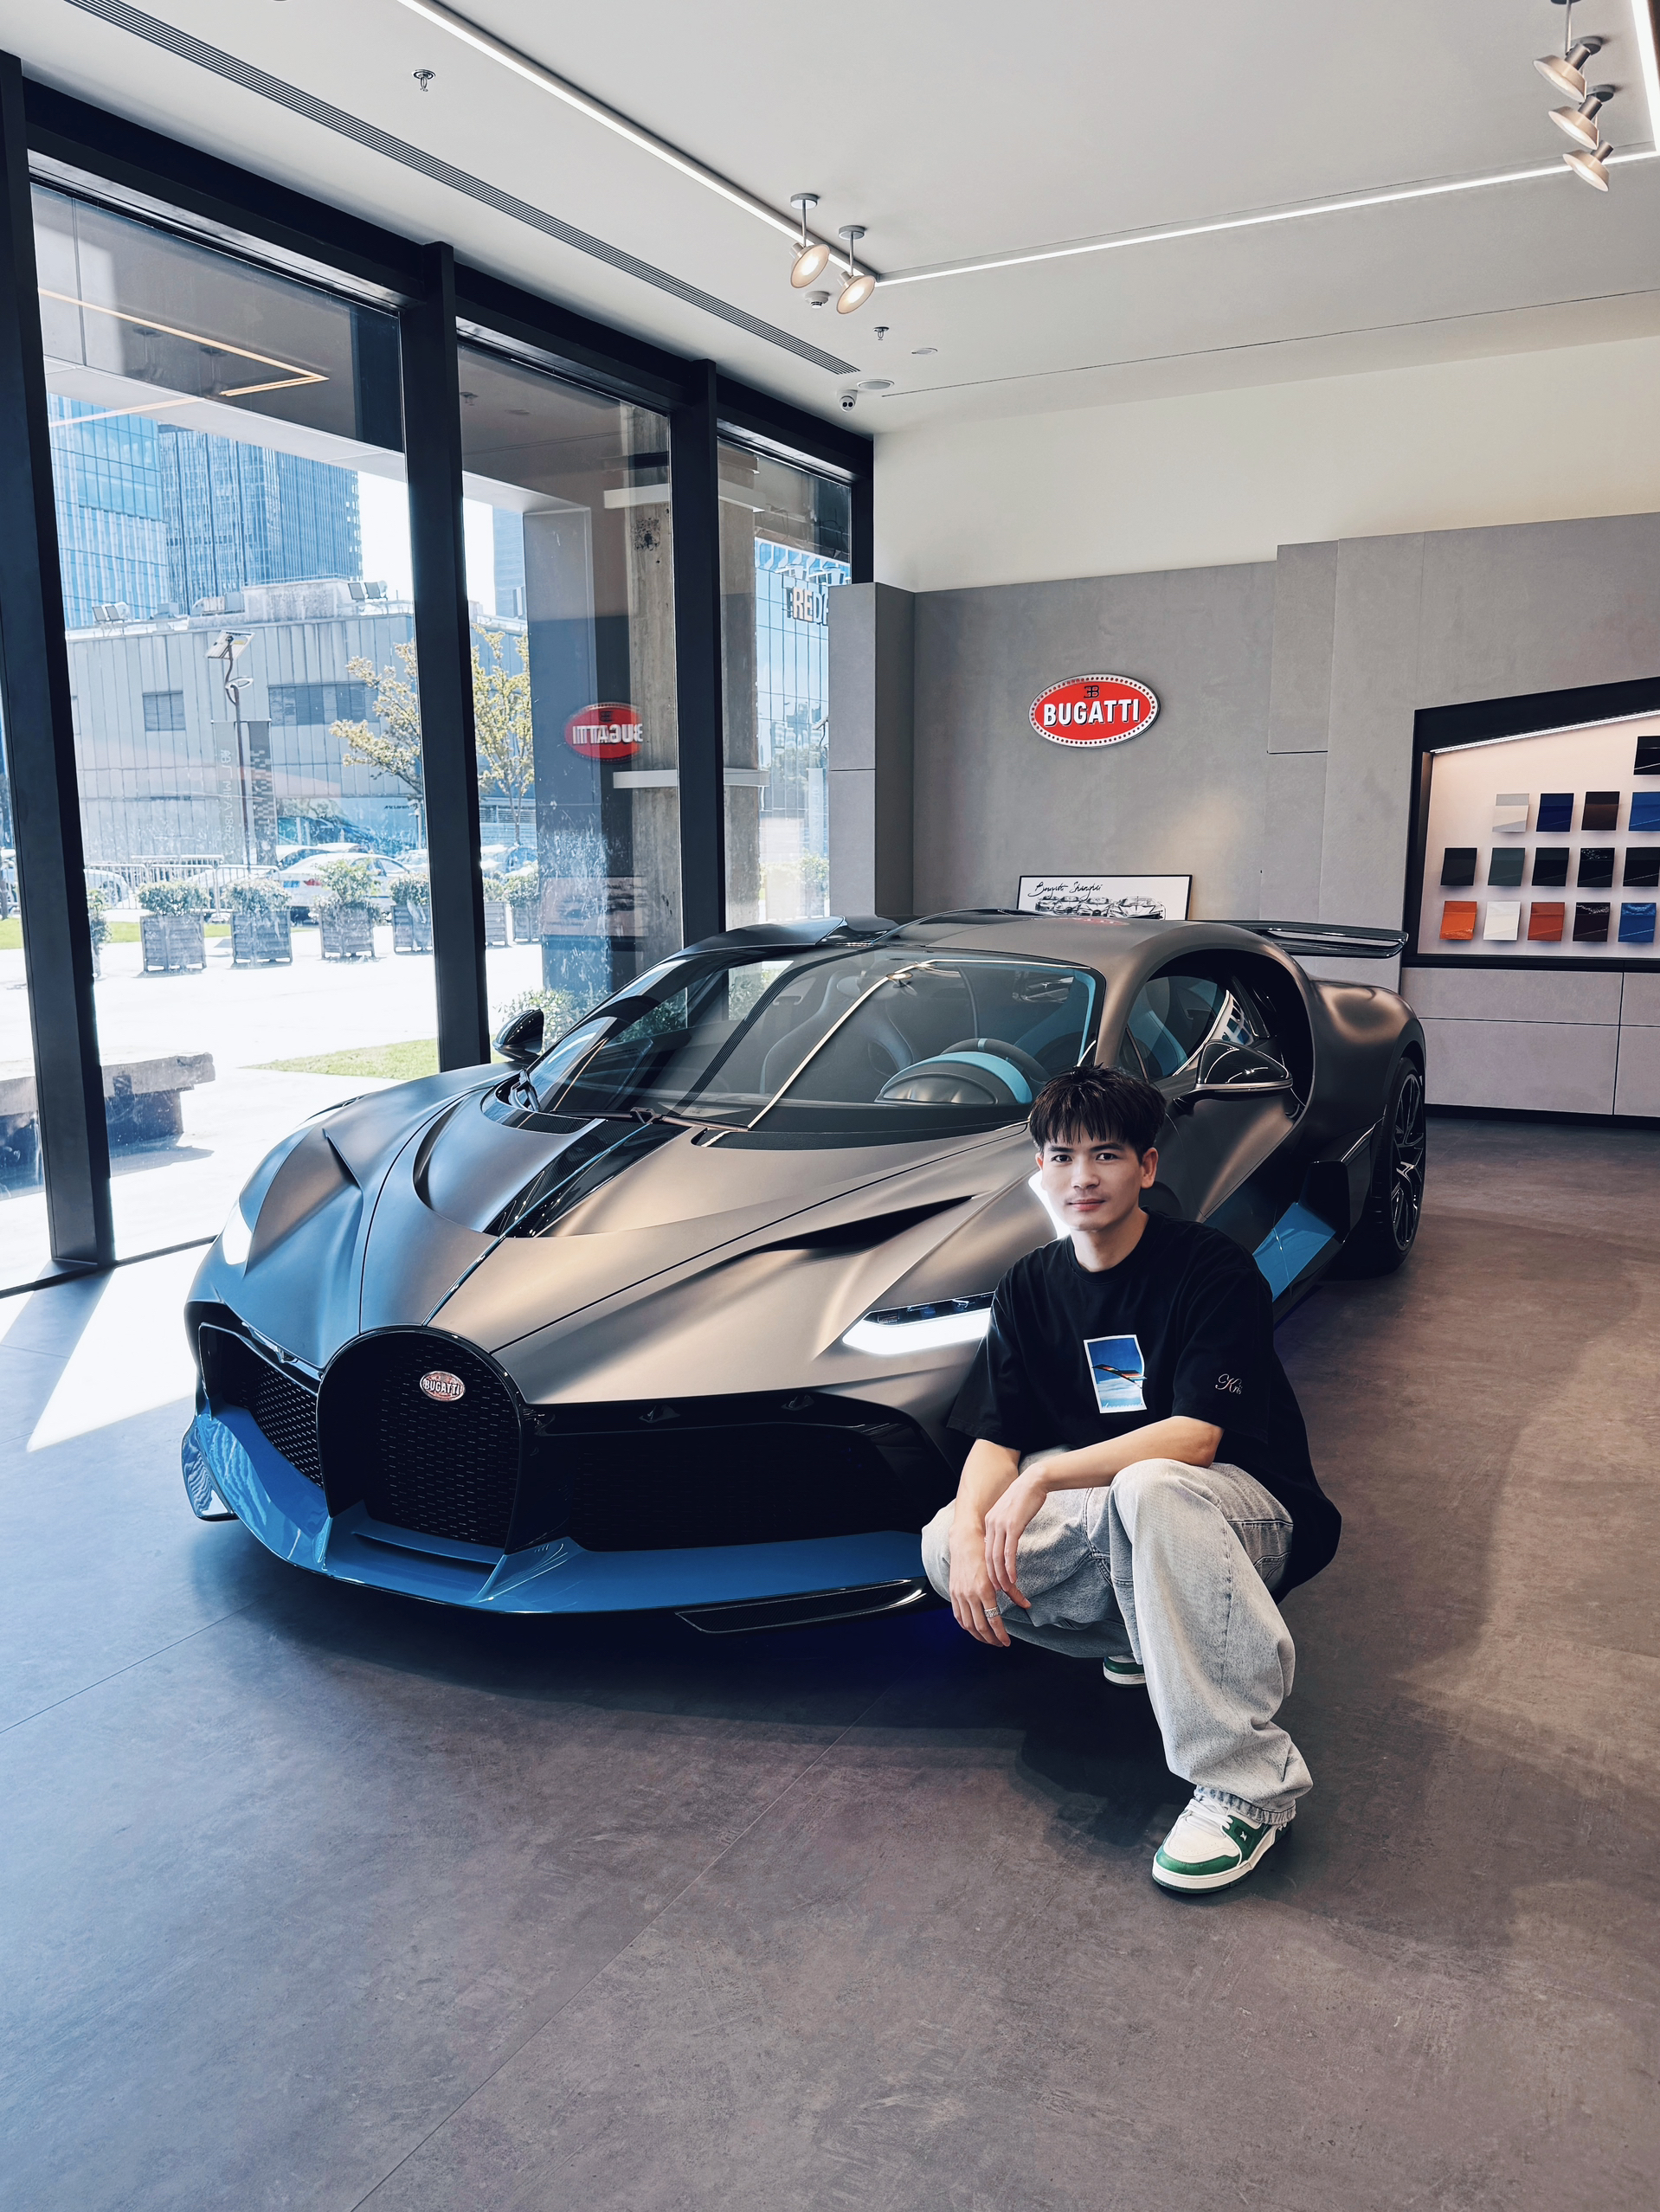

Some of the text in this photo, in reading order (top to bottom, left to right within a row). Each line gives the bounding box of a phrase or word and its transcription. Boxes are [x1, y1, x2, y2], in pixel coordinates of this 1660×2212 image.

[1043, 698, 1140, 727] BUGATTI
[1069, 881, 1103, 902] Shanghai
[424, 1379, 460, 1396] BUGATTI
